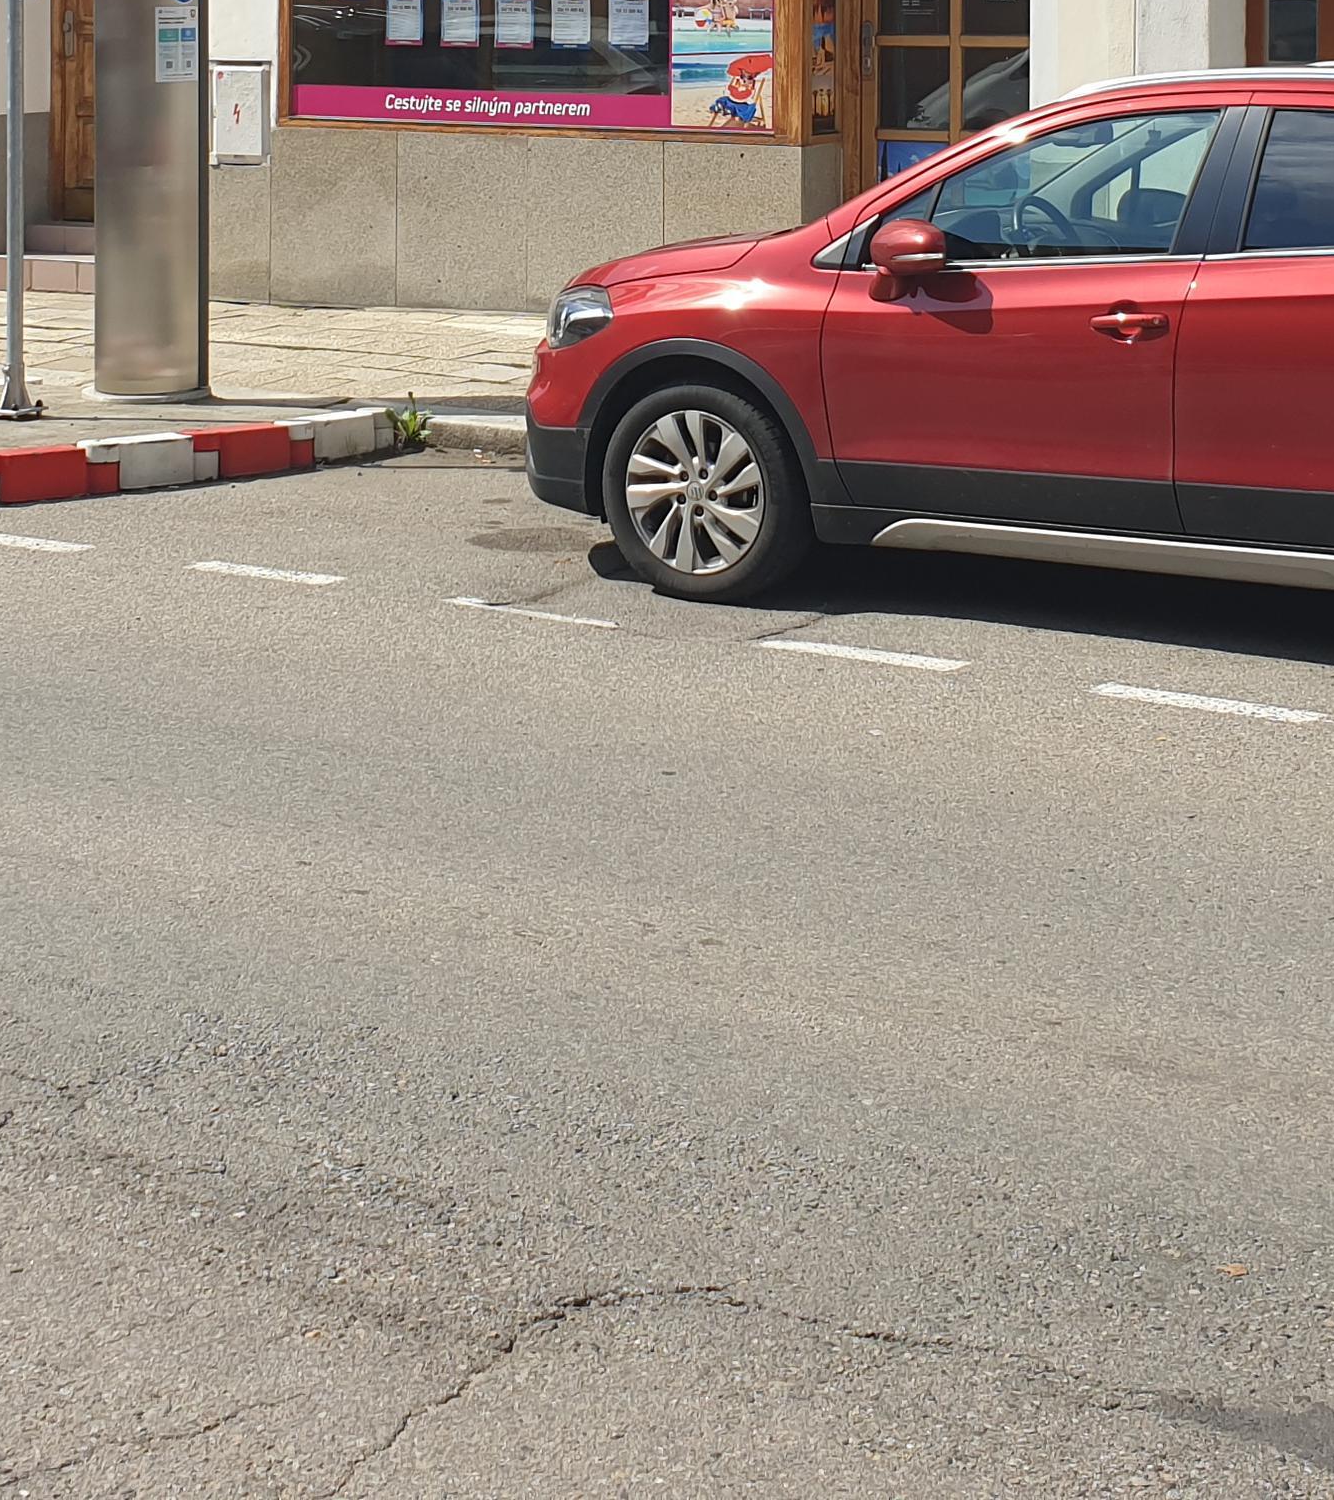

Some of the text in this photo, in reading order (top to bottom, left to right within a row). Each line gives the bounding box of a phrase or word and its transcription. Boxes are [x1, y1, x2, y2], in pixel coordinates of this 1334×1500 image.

[385, 94, 590, 116] Cestujte se silným partnerem
